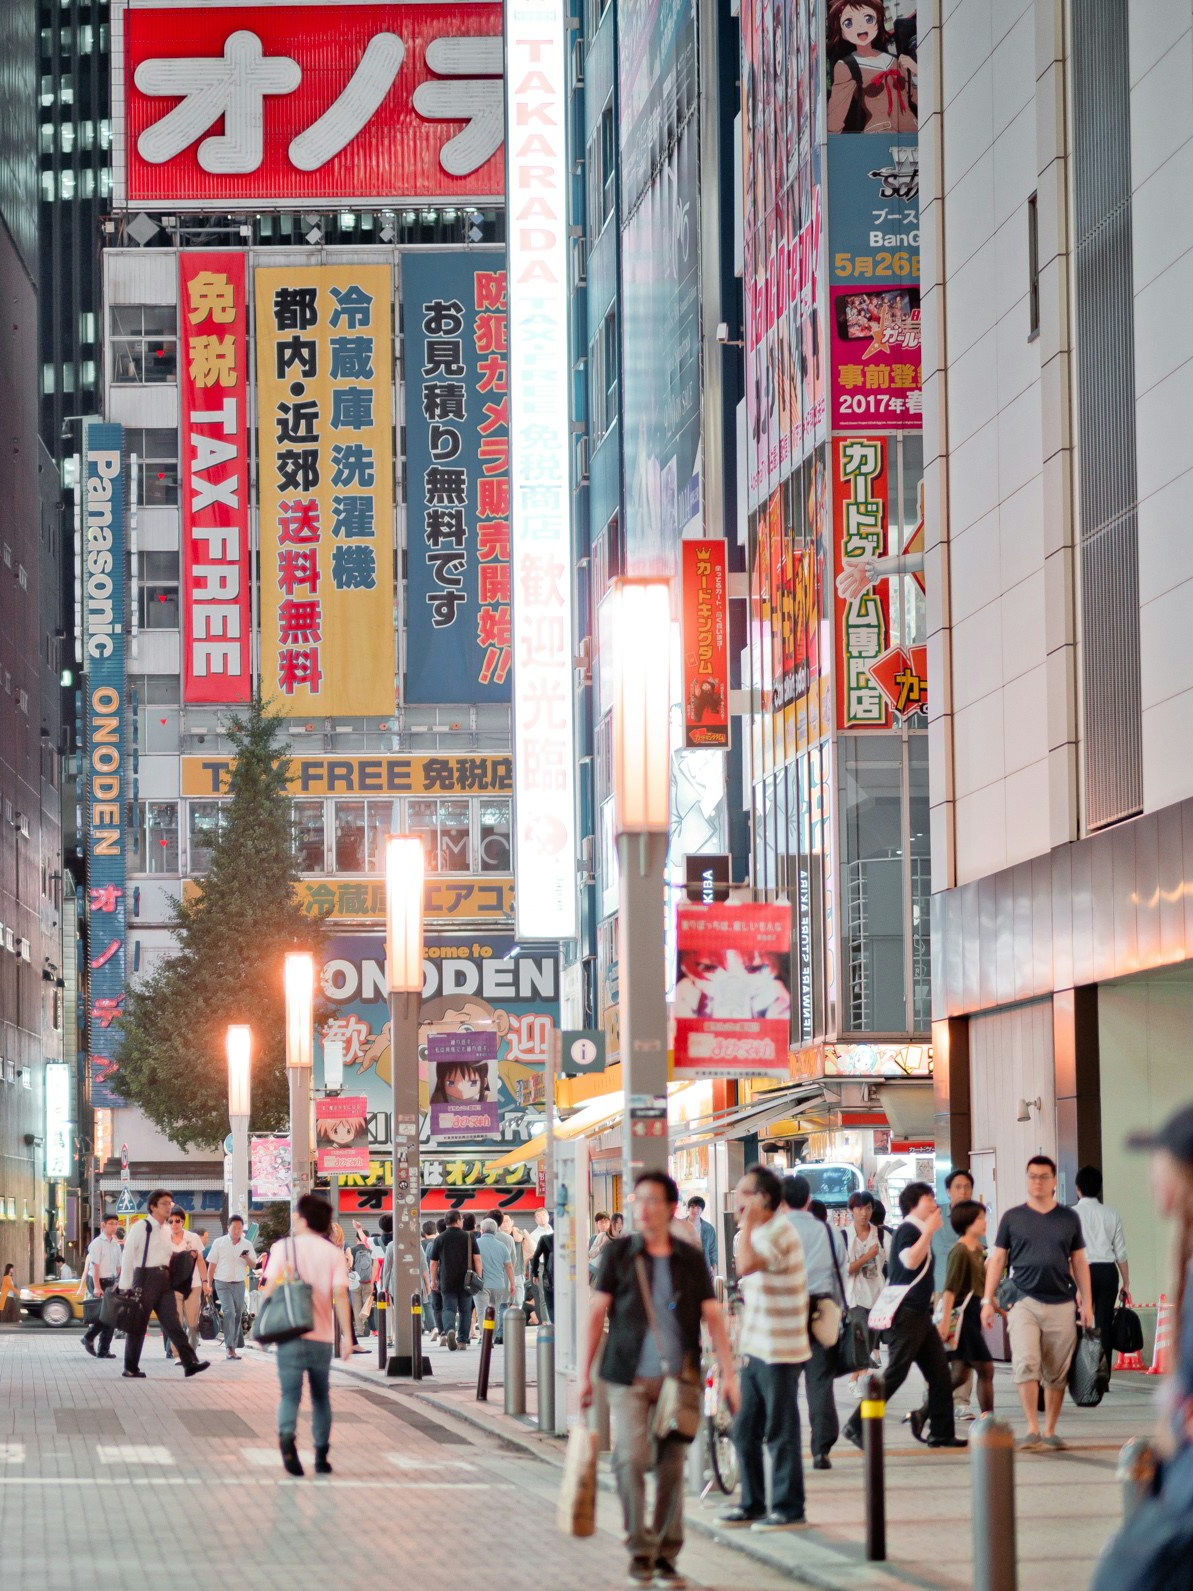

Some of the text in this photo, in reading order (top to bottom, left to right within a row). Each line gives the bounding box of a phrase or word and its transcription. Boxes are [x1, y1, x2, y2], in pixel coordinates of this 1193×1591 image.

[514, 39, 558, 283] TAKARADA
[88, 451, 121, 659] Panasonic
[187, 270, 241, 677] 免税 TAX FREE
[422, 300, 468, 629] お見積り無料です
[696, 562, 712, 674] カードキングダム
[844, 444, 880, 719] カードゲム専門店
[91, 687, 122, 857] ONODEN
[301, 760, 412, 791] FREE
[422, 757, 513, 791] 免税店
[90, 884, 125, 1083] オノデン
[472, 943, 493, 957] to
